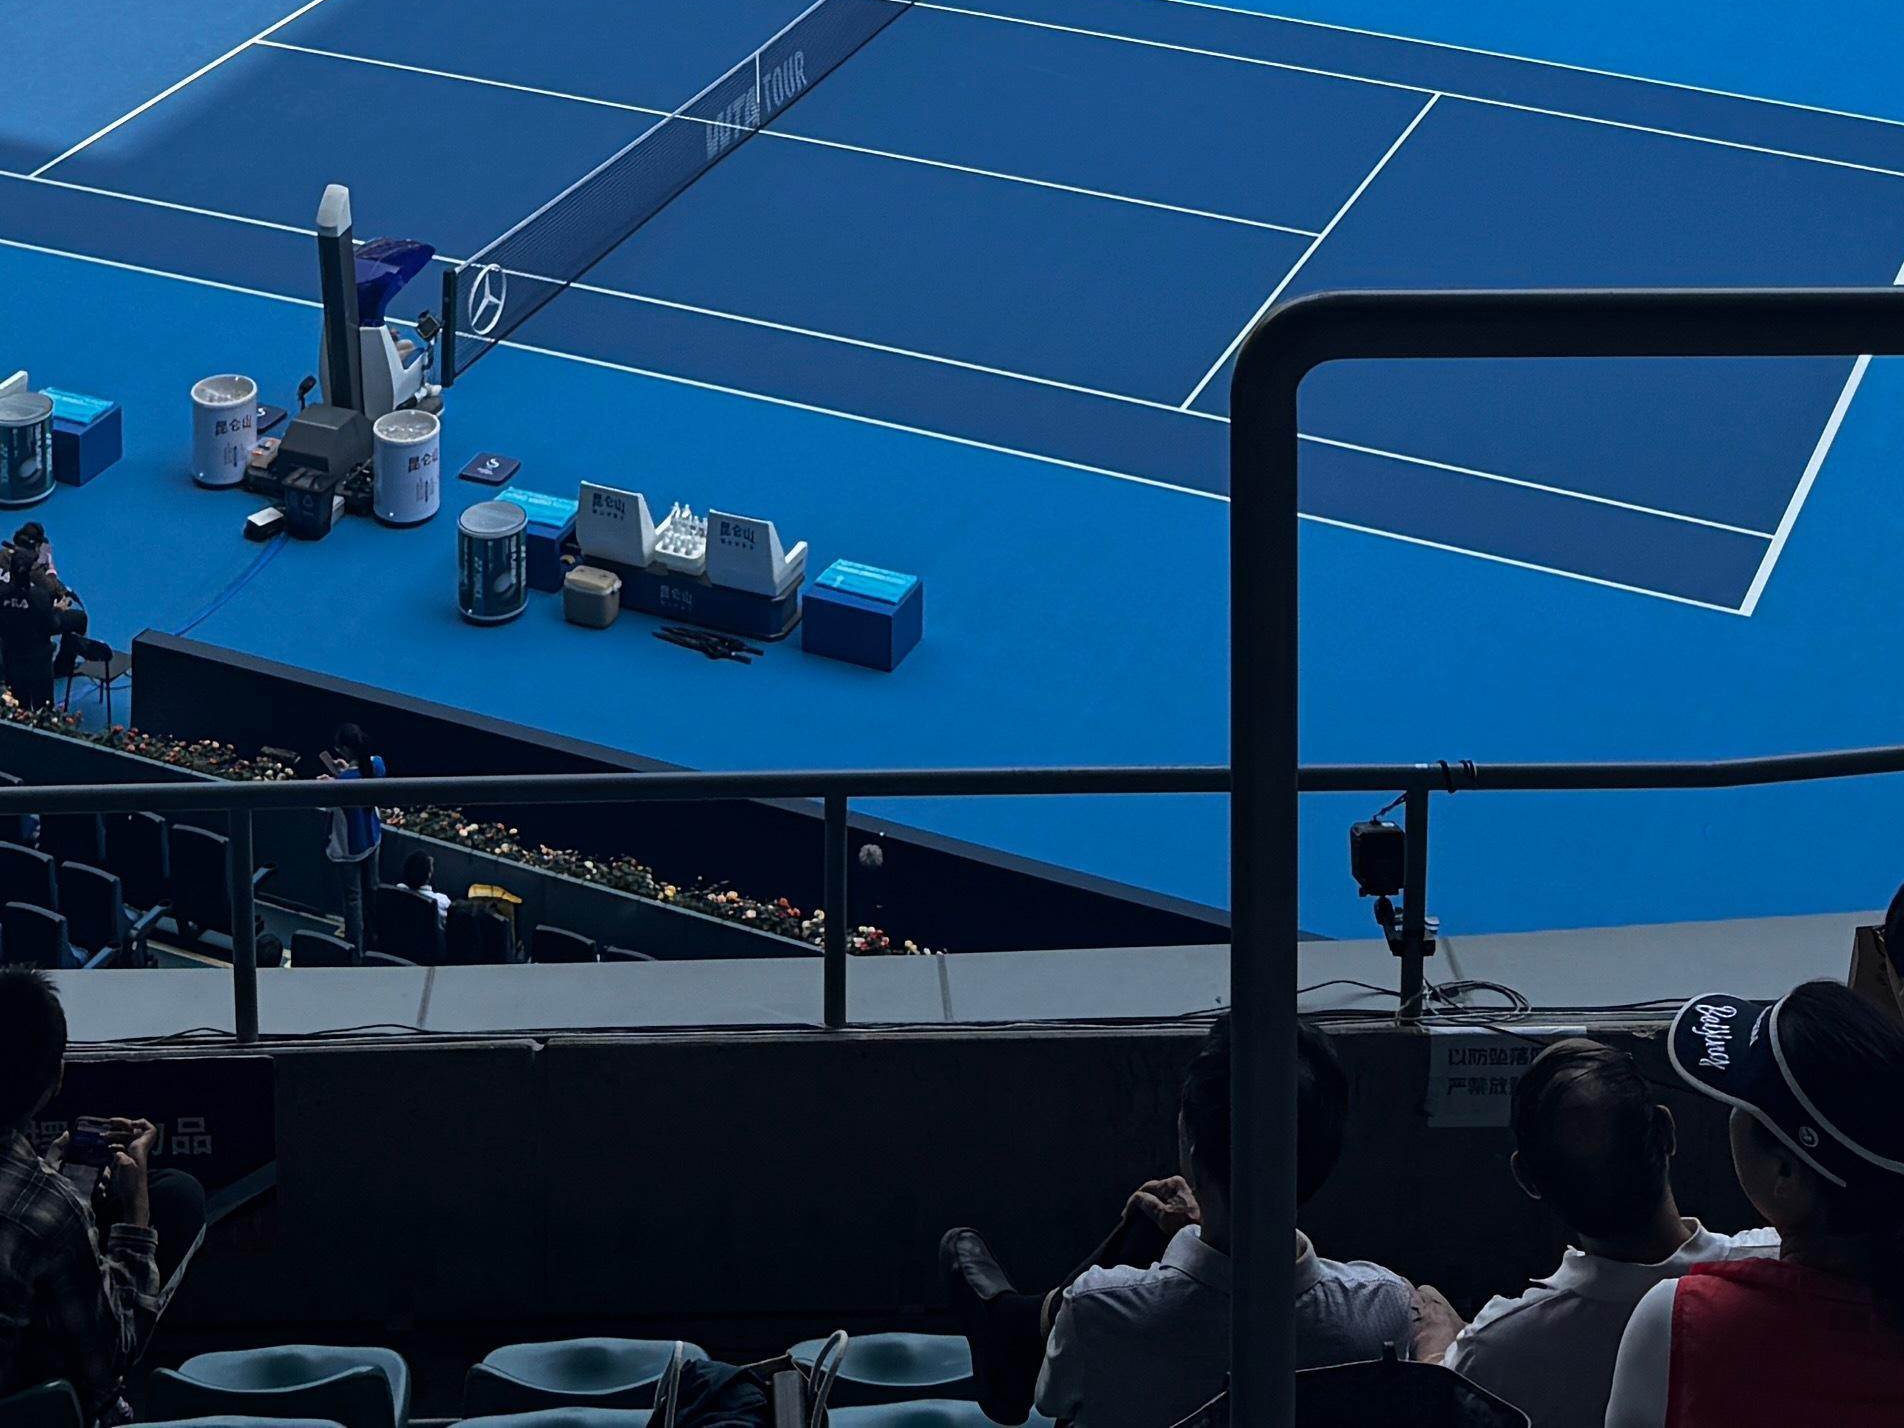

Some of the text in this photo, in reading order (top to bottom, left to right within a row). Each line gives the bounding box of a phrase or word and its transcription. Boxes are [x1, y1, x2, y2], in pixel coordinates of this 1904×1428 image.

[762, 50, 808, 114] TOUR
[215, 415, 252, 438] 昆仑山
[592, 492, 626, 515] 昆仑山
[720, 521, 755, 544] 昆仑山
